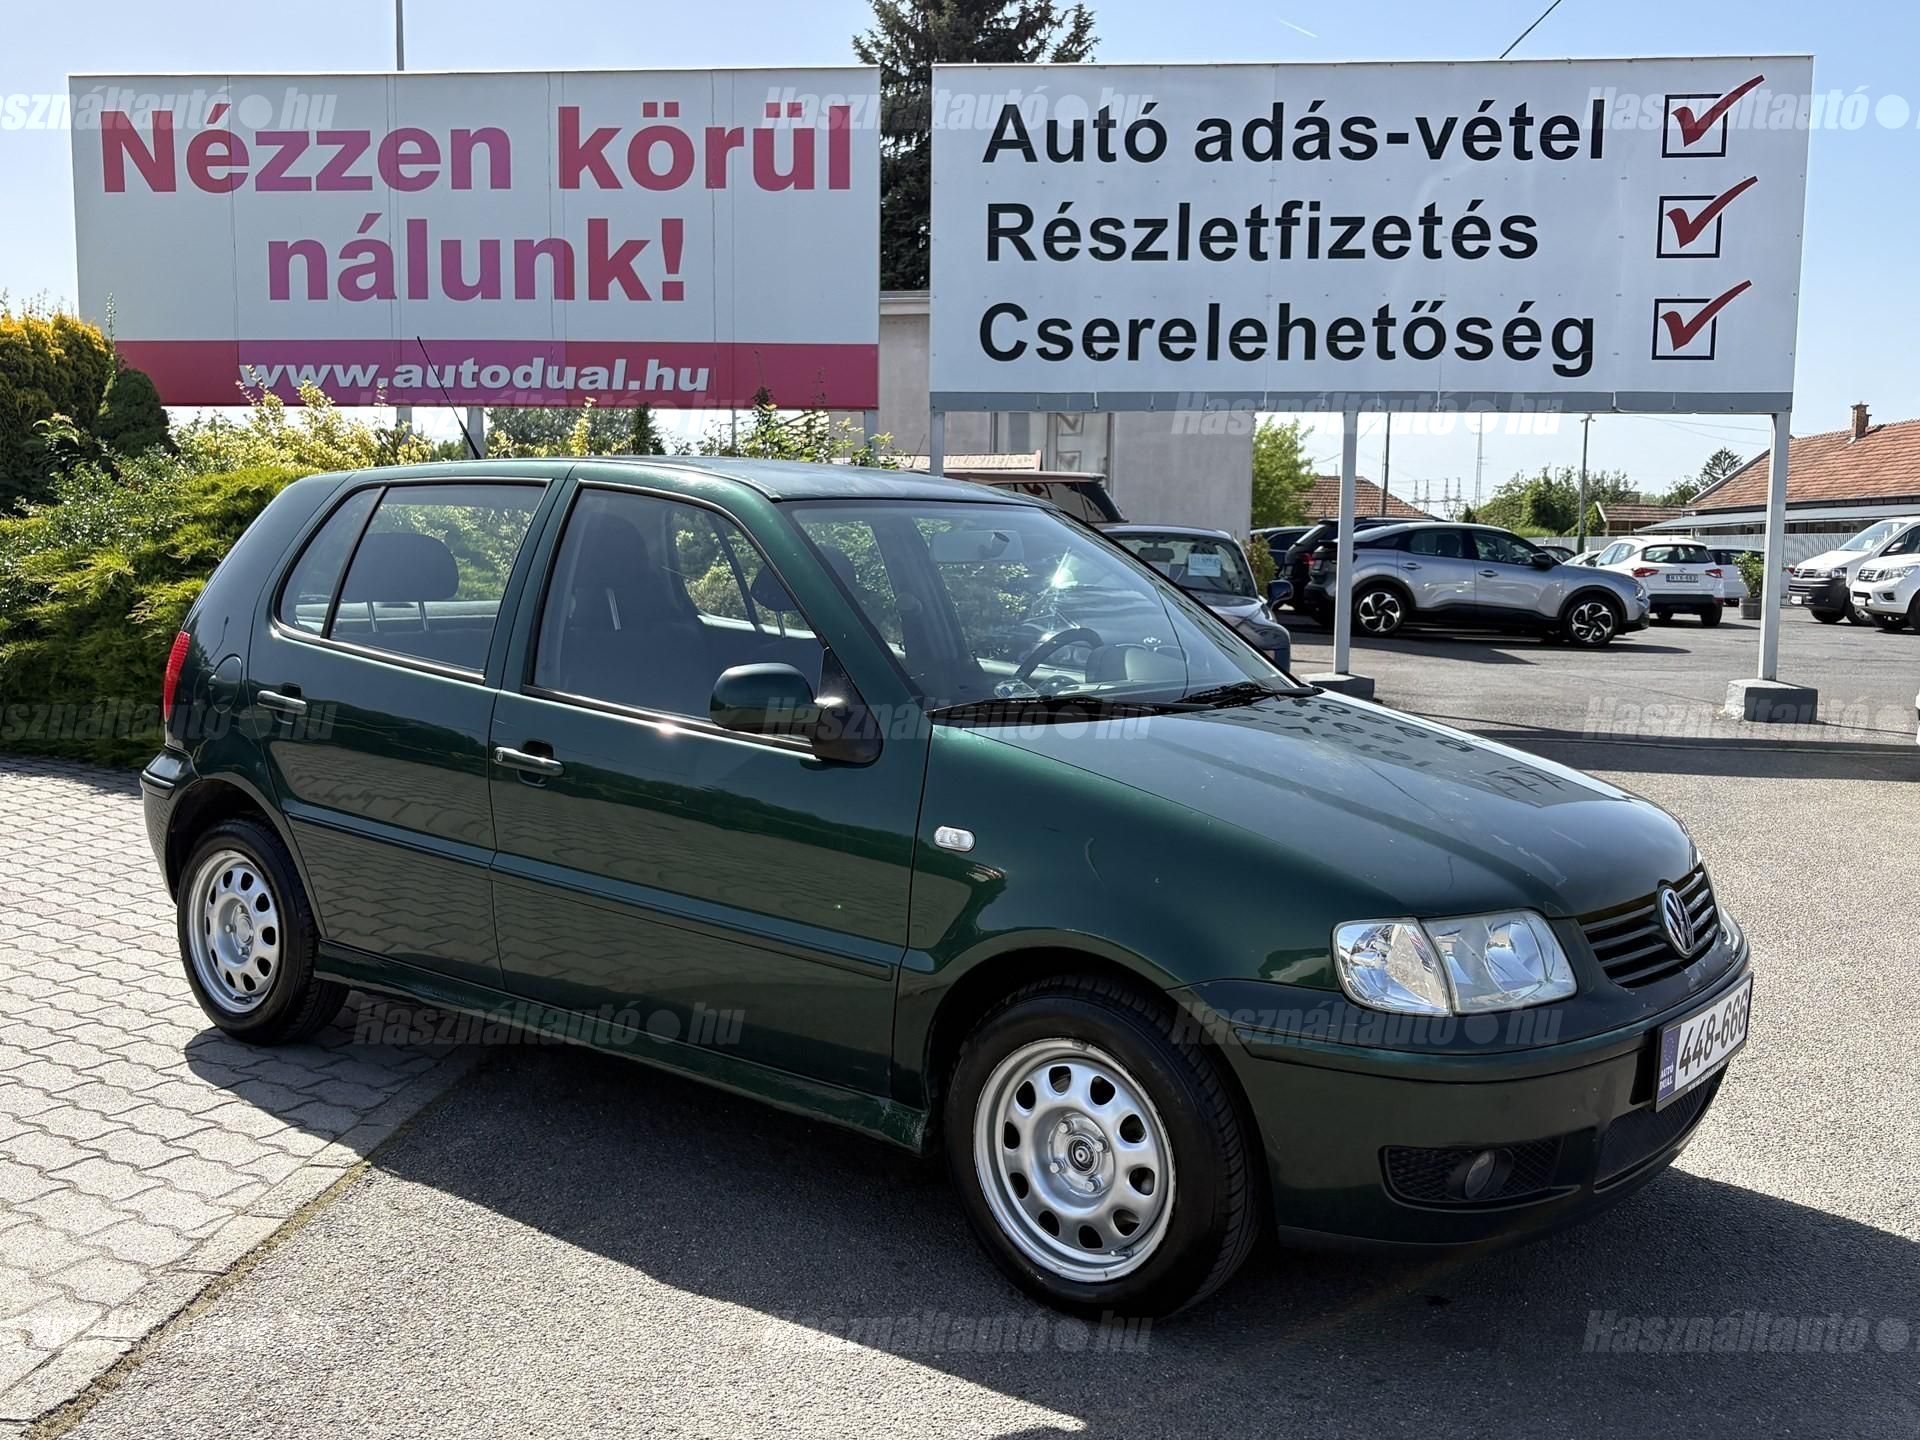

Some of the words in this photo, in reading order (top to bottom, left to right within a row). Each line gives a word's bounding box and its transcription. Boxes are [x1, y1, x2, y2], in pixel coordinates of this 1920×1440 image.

[104, 106, 508, 192] Nézzen
[560, 103, 849, 190] körül
[983, 102, 1168, 163] Autó
[1195, 98, 1605, 163] adás-vétel
[269, 214, 685, 301] nálunk!
[987, 199, 1539, 262] Részletfizetés
[239, 357, 709, 392] www.autodual.hu
[980, 300, 1595, 378] Cserelehetőség
[1679, 988, 1748, 1077] 448-666
